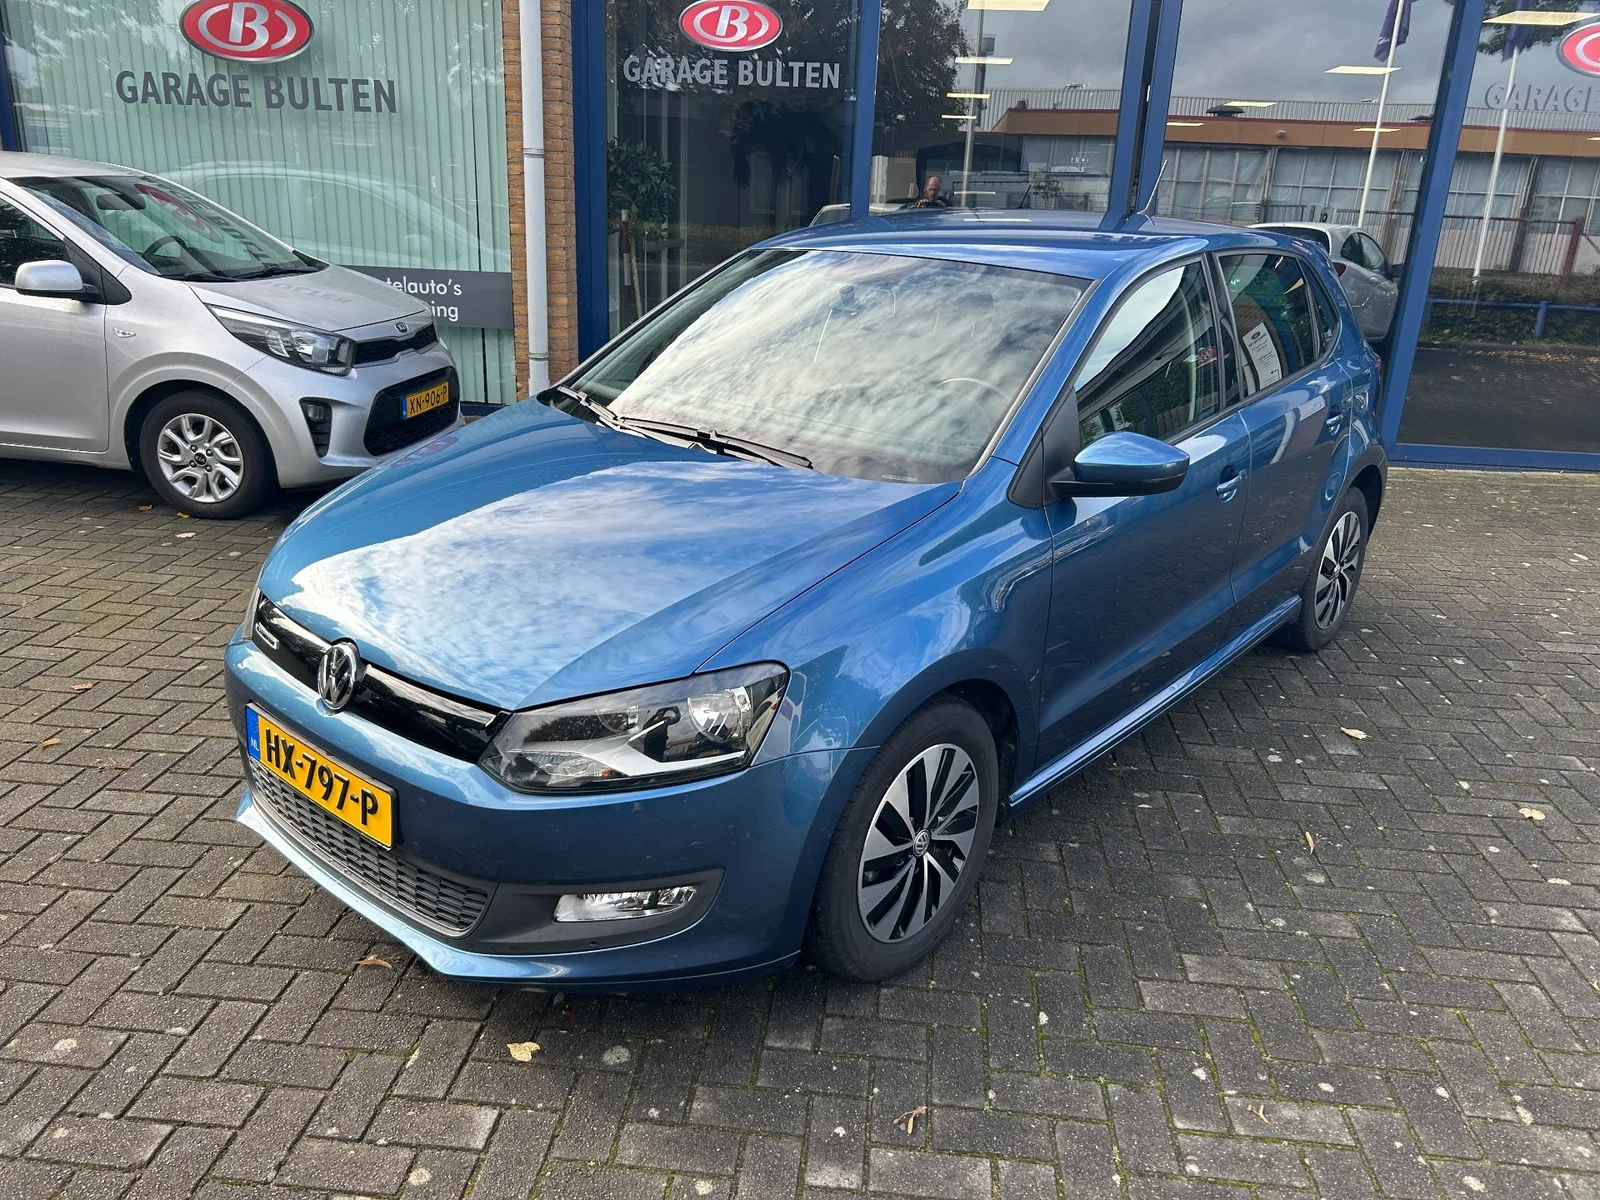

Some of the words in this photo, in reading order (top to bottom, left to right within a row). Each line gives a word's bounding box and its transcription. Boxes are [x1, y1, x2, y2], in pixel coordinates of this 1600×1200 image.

[623, 56, 728, 85] GARAGE
[738, 60, 840, 89] BULTEN
[115, 70, 252, 108] GARAGE
[263, 75, 397, 114] BULTEN
[386, 276, 462, 296] telauto's
[430, 301, 459, 322] ing
[409, 386, 448, 414] XN-906-P
[265, 727, 378, 826] HX-797-P
